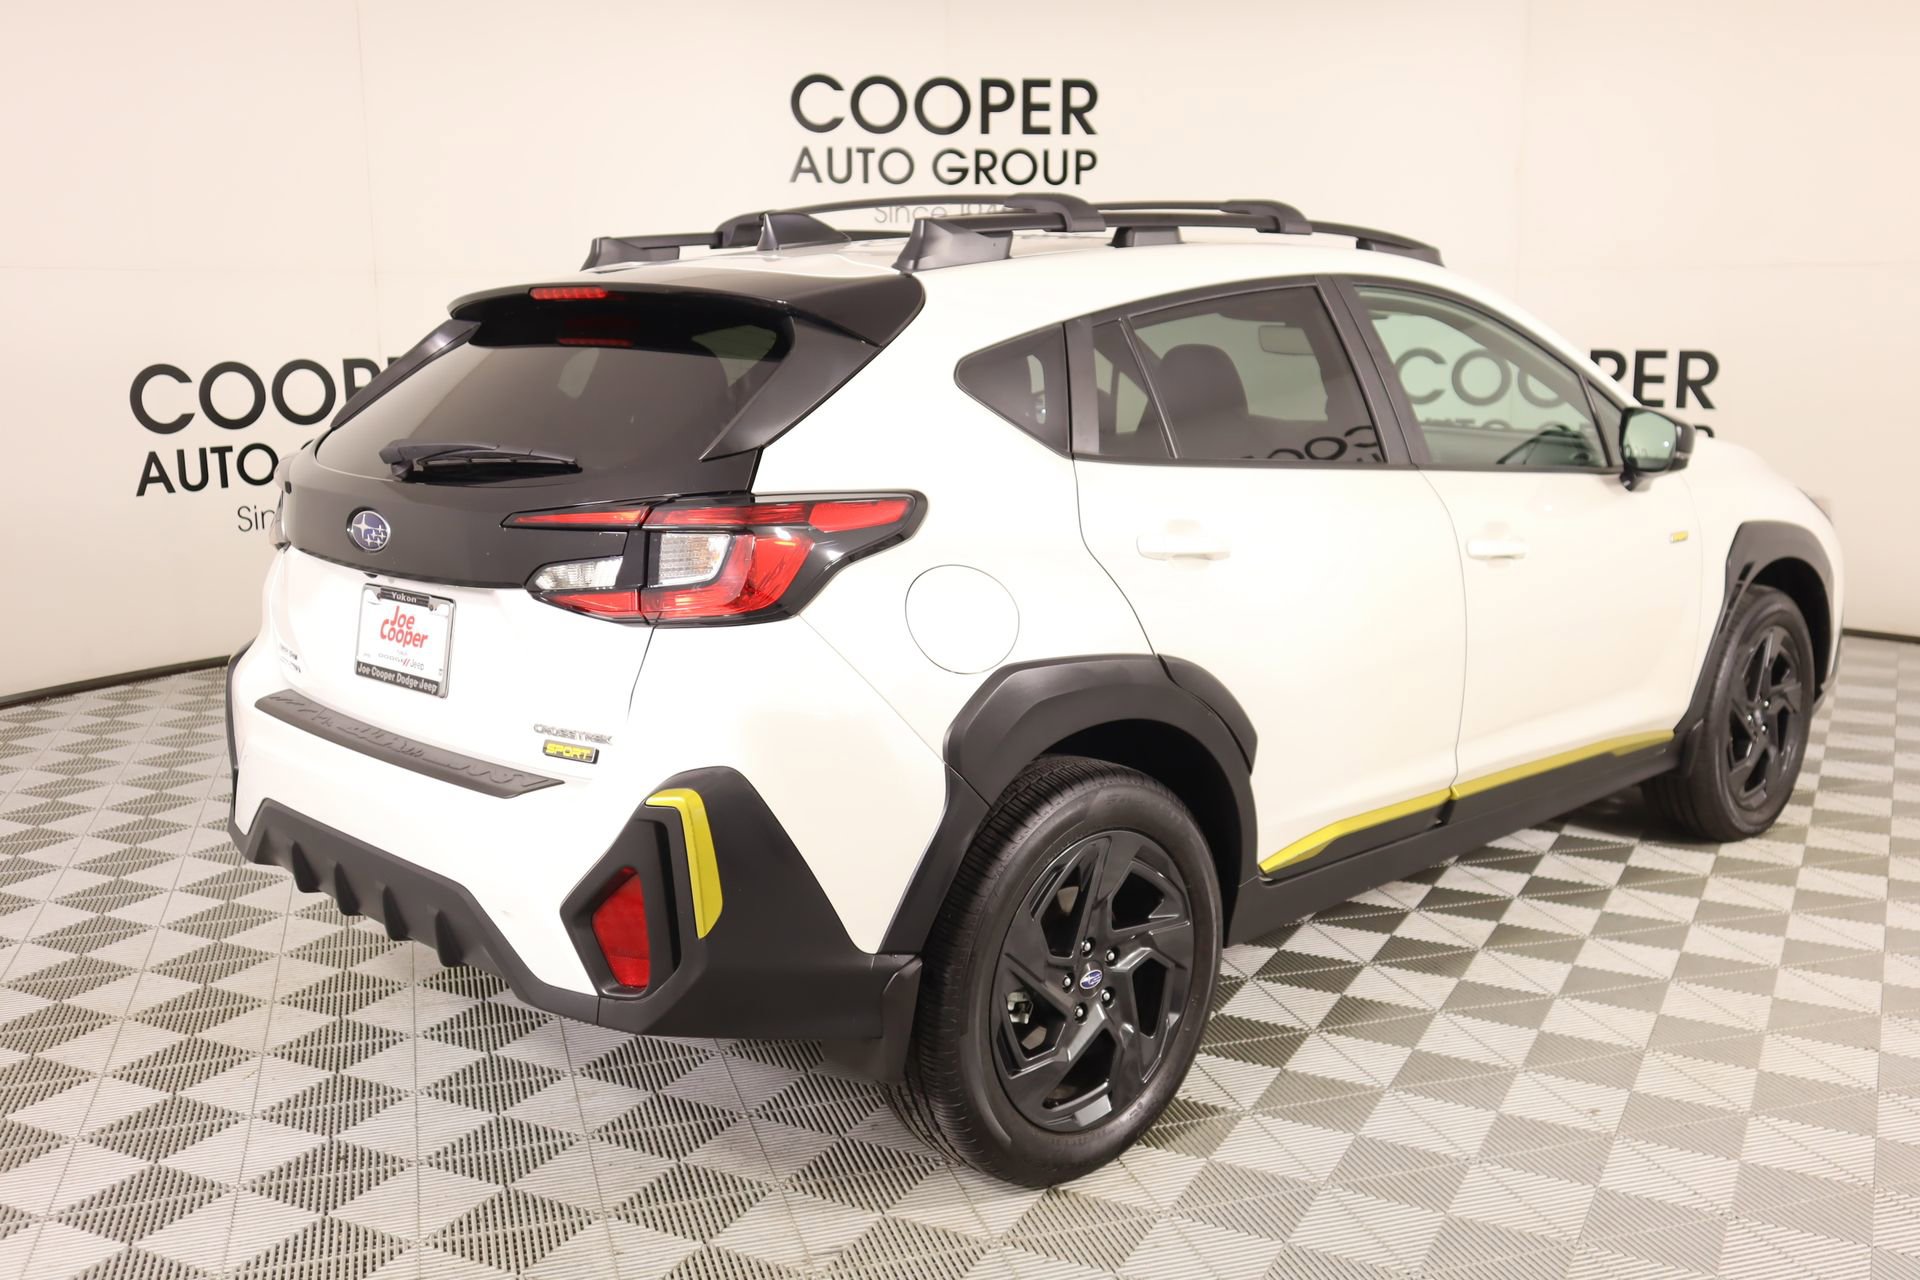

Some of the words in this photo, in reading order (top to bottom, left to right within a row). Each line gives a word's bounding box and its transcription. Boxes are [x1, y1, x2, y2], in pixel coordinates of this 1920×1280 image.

[790, 74, 1099, 136] COOPER
[789, 146, 915, 185] AUTO
[932, 148, 1099, 186] GROUP
[129, 357, 403, 435] COOP
[136, 442, 279, 497] AUTO
[237, 504, 276, 533] Sin
[391, 591, 417, 604] Yukon
[390, 605, 416, 630] Joe
[380, 618, 429, 649] Cooper
[357, 662, 371, 675] Joe
[371, 666, 396, 682] Cooper
[396, 672, 419, 689] Dodge
[419, 678, 438, 694] Jeep
[545, 743, 592, 759] SPORT
